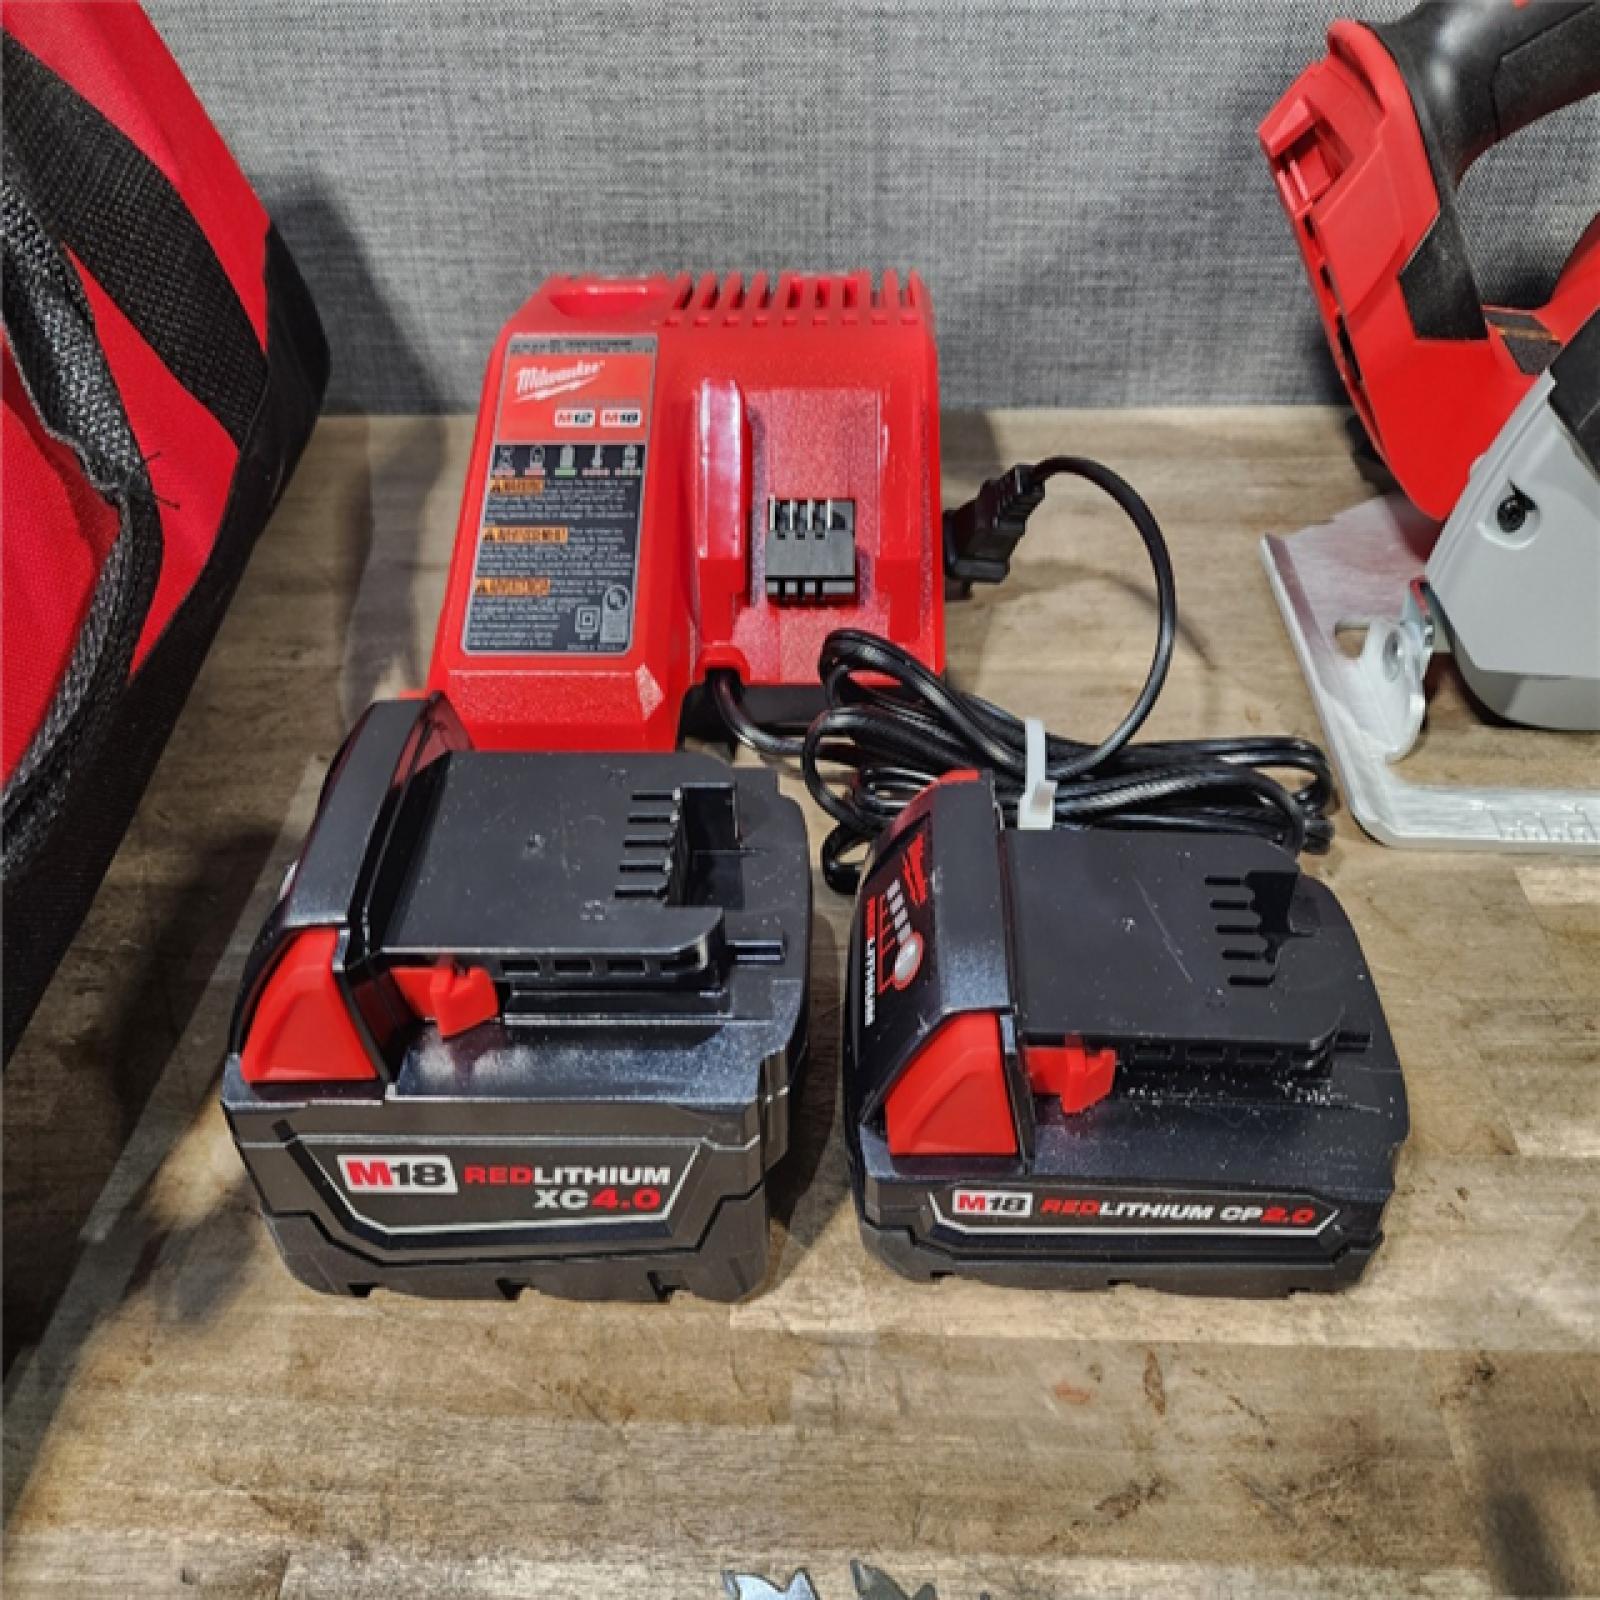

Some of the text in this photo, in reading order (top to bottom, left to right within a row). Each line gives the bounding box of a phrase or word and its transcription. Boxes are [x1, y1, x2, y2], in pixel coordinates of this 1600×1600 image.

[864, 895, 877, 1027] LITHIUM
[344, 1159, 671, 1187] M18 REDLITHIUM
[533, 1188, 661, 1211] XC4.0
[957, 1194, 1316, 1225] M18 REDLITHIUM CP2.0
